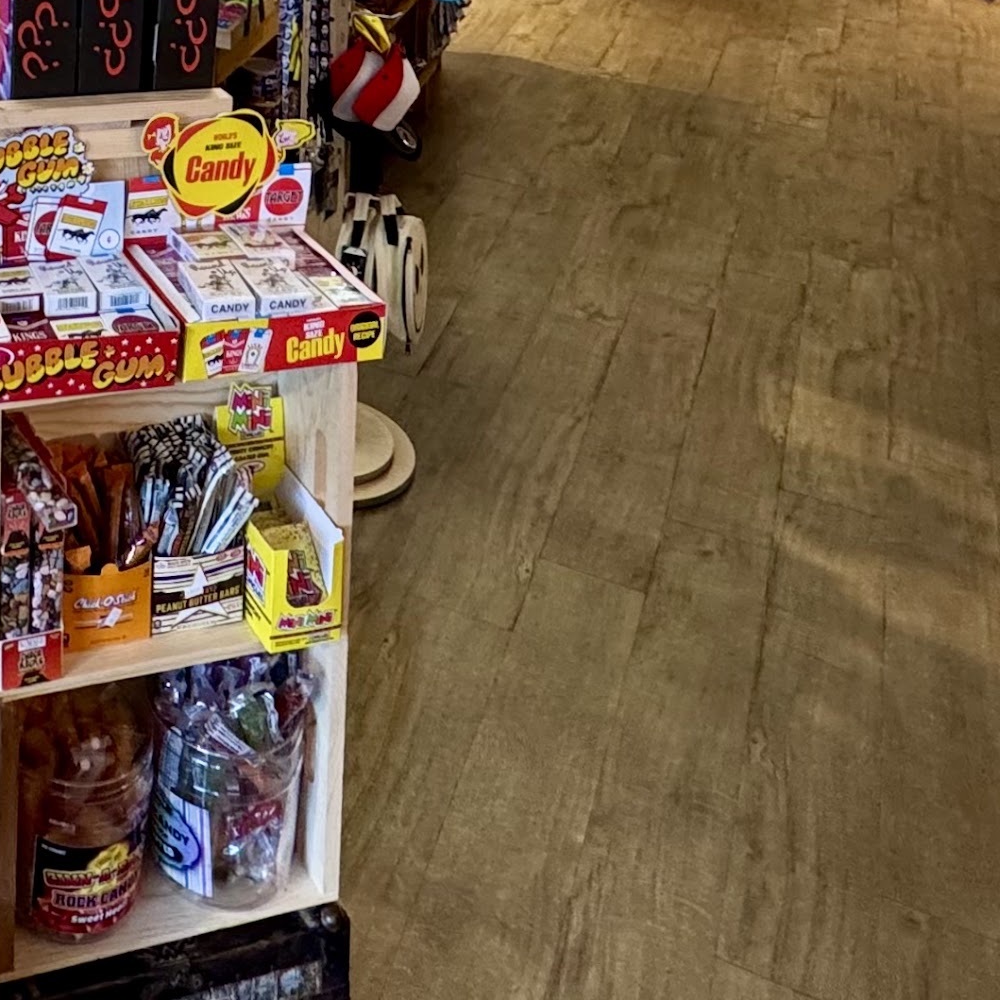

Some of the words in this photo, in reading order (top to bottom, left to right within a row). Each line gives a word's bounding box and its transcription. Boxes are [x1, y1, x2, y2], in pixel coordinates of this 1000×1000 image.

[16, 156, 81, 188] GUM
[185, 151, 257, 187] Candy
[211, 303, 250, 314] CANDY
[269, 300, 306, 311] CANDY
[12, 330, 49, 342] KINGS
[286, 328, 346, 364] Candy
[92, 354, 166, 390] GUM
[156, 599, 187, 615] PEANUT
[189, 593, 219, 609] BUTTER
[219, 586, 241, 601] BARS
[55, 893, 97, 908] ROCK
[71, 908, 104, 923] Sweet
